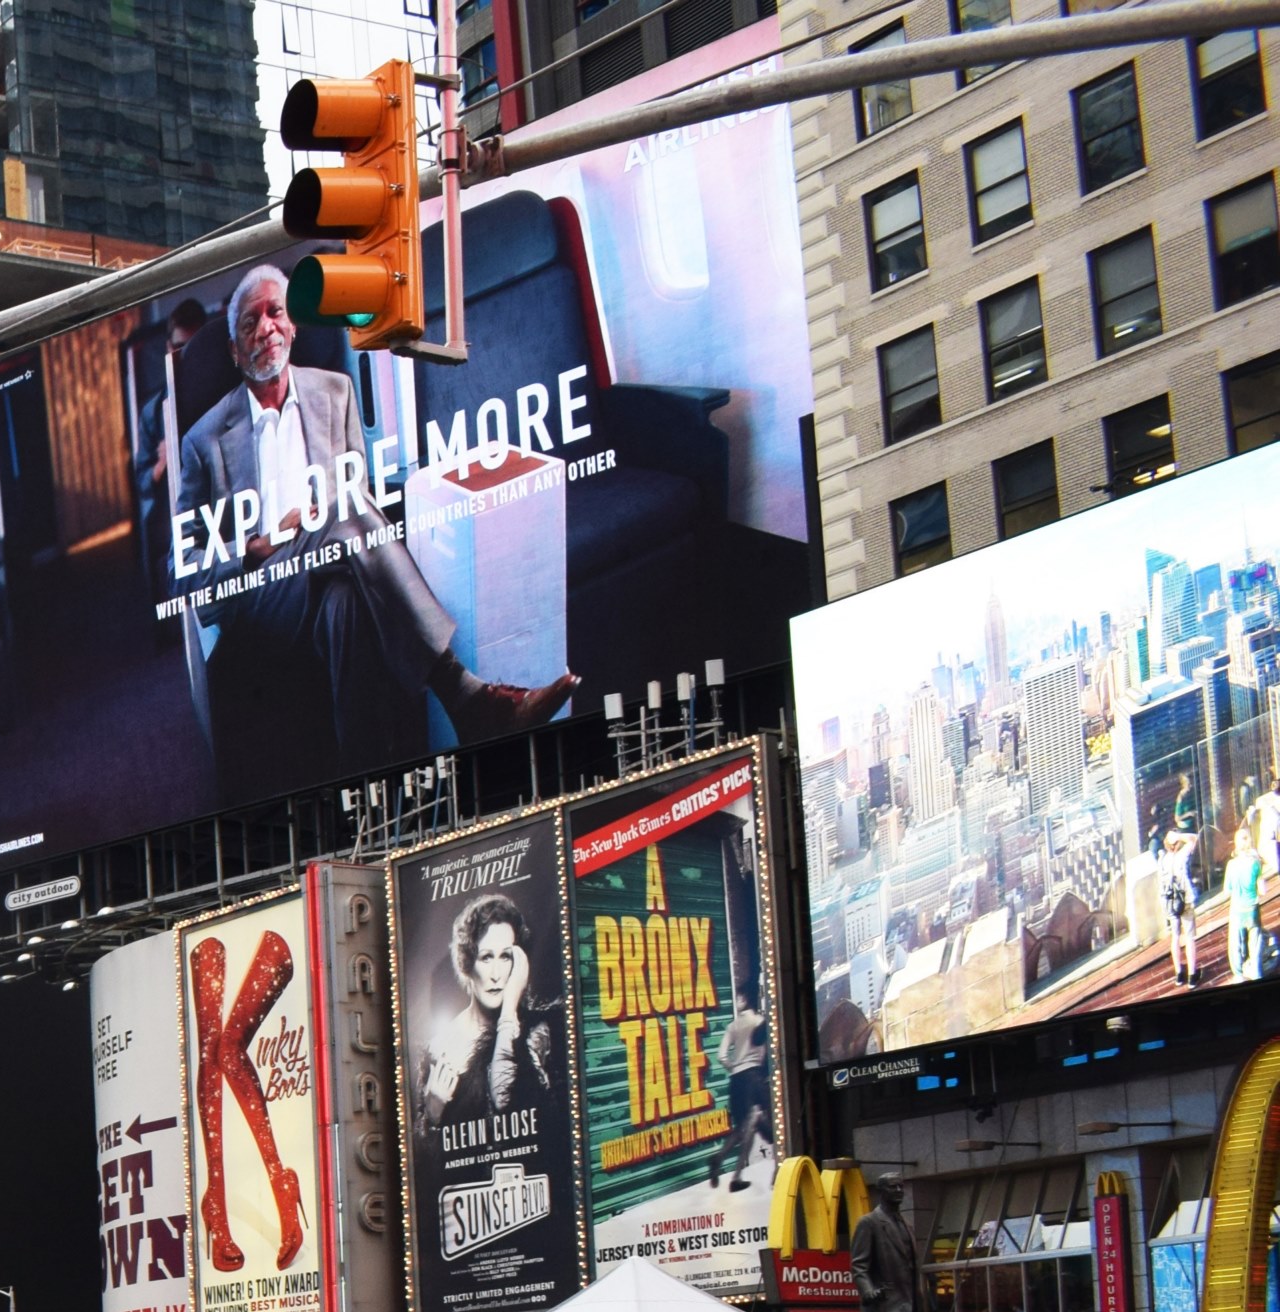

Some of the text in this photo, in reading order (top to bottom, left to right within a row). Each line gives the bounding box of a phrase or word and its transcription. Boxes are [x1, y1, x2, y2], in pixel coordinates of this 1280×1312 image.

[172, 365, 593, 579] EXPLORE MORE
[156, 449, 616, 621] WITH THE AIRLINE THAT FLIES TO MORE COUNTRIES THAN ANY OTHER
[573, 764, 752, 864] The New York Times CRITICS' PICK
[12, 882, 74, 904] city outdoor
[646, 843, 666, 911] A
[595, 914, 717, 1021] BRONX
[96, 1014, 111, 1039] SET
[96, 1060, 118, 1086] FREE
[263, 1063, 312, 1103] Boots
[344, 893, 387, 1233] PALACE
[618, 1012, 712, 1126] TALE
[443, 1107, 538, 1152] GLENN CLOSE
[601, 1110, 731, 1171] BROADWAY'S HIT MUSICAL
[444, 1144, 538, 1169] ANDREW LLOYD WEBBER'S
[452, 1179, 548, 1247] SUNSET BLVD.
[652, 1212, 725, 1237] COMBINATION OF
[597, 1230, 736, 1263] JERSEY BOYS & WEST SIDE
[204, 1271, 320, 1305] WINNER! 6 TONY AWARD
[251, 1298, 276, 1312] BEST
[279, 1293, 320, 1309] MUSICA
[443, 1281, 555, 1304] STRICTLY LIMITED ENGAGEMENT
